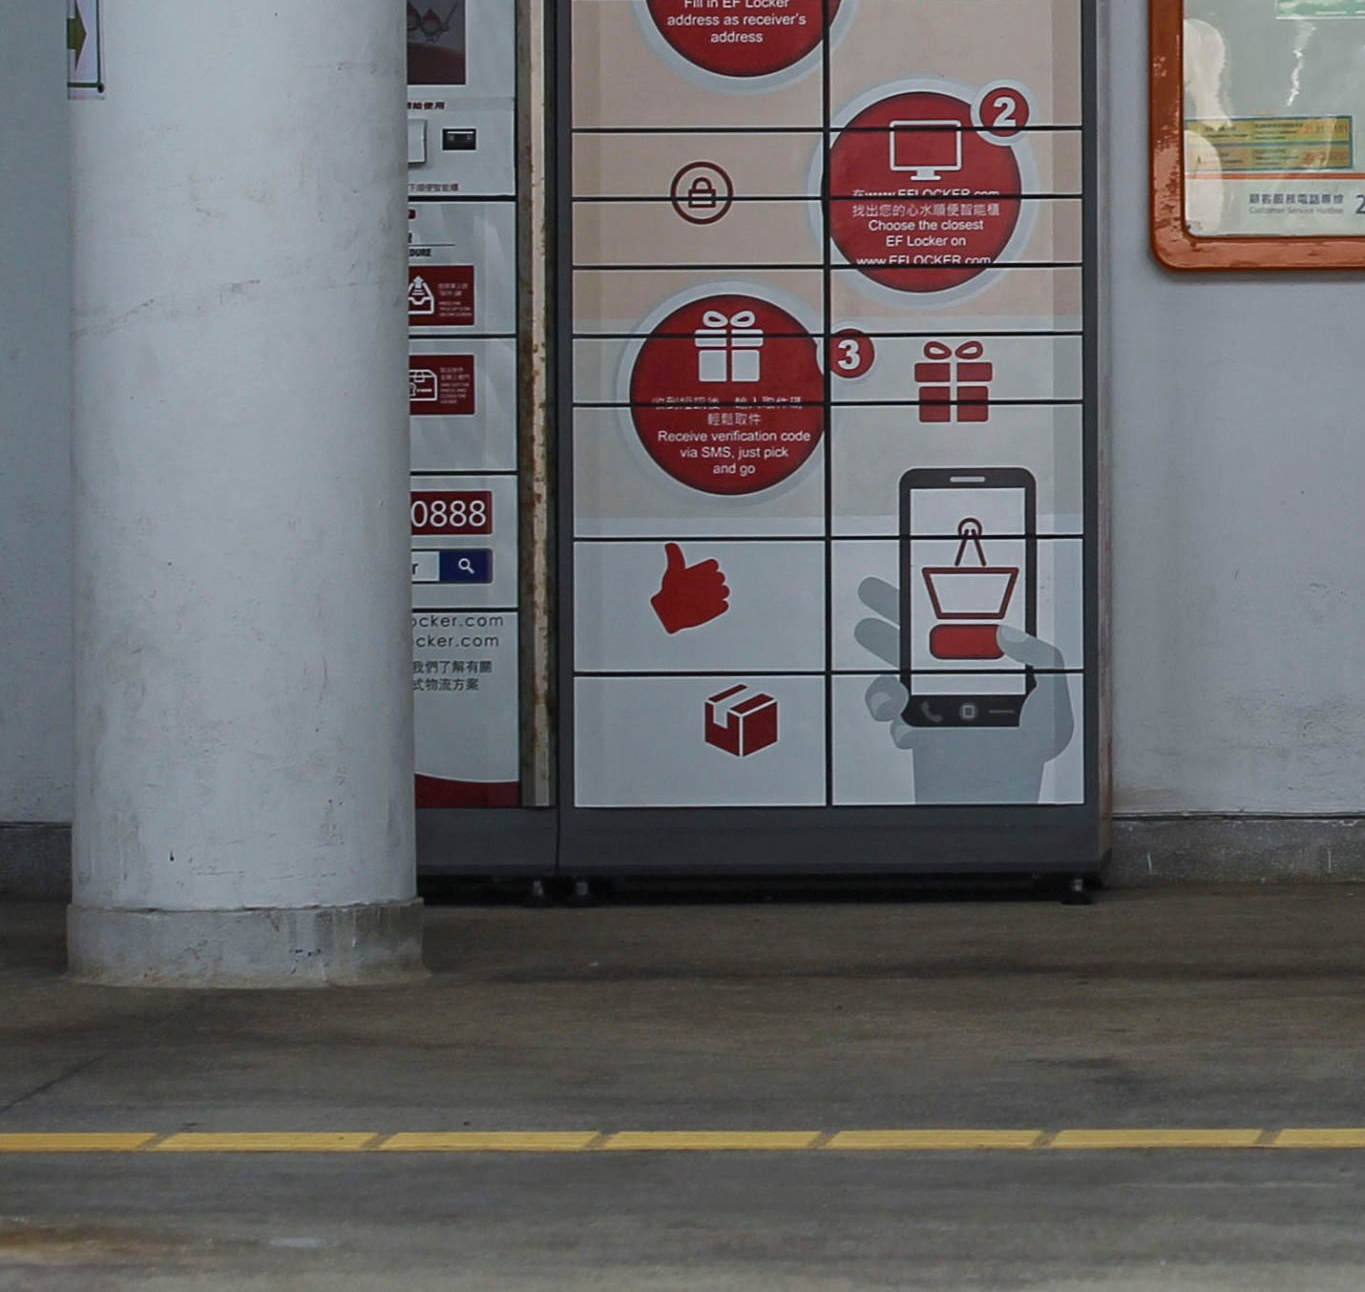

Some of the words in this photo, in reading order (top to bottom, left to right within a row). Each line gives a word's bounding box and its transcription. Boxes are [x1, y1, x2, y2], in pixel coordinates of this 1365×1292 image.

[667, 14, 720, 26] address
[723, 16, 739, 26] as
[743, 13, 807, 26] receiver's
[711, 31, 764, 43] address
[994, 96, 1016, 127] 2
[868, 219, 915, 231] Choose
[919, 219, 938, 230] the
[940, 219, 984, 230] closest
[886, 235, 903, 247] EF
[907, 235, 948, 247] Locker
[951, 237, 966, 246] on
[838, 340, 861, 369] 3
[658, 430, 707, 441] Receive
[711, 430, 777, 441] verification
[781, 430, 811, 441] code
[680, 447, 698, 458] via
[701, 446, 734, 459] SMS,
[738, 447, 760, 460] just
[764, 446, 789, 460] pick
[713, 463, 736, 474] and
[740, 465, 756, 477] go
[411, 500, 486, 527] 0888
